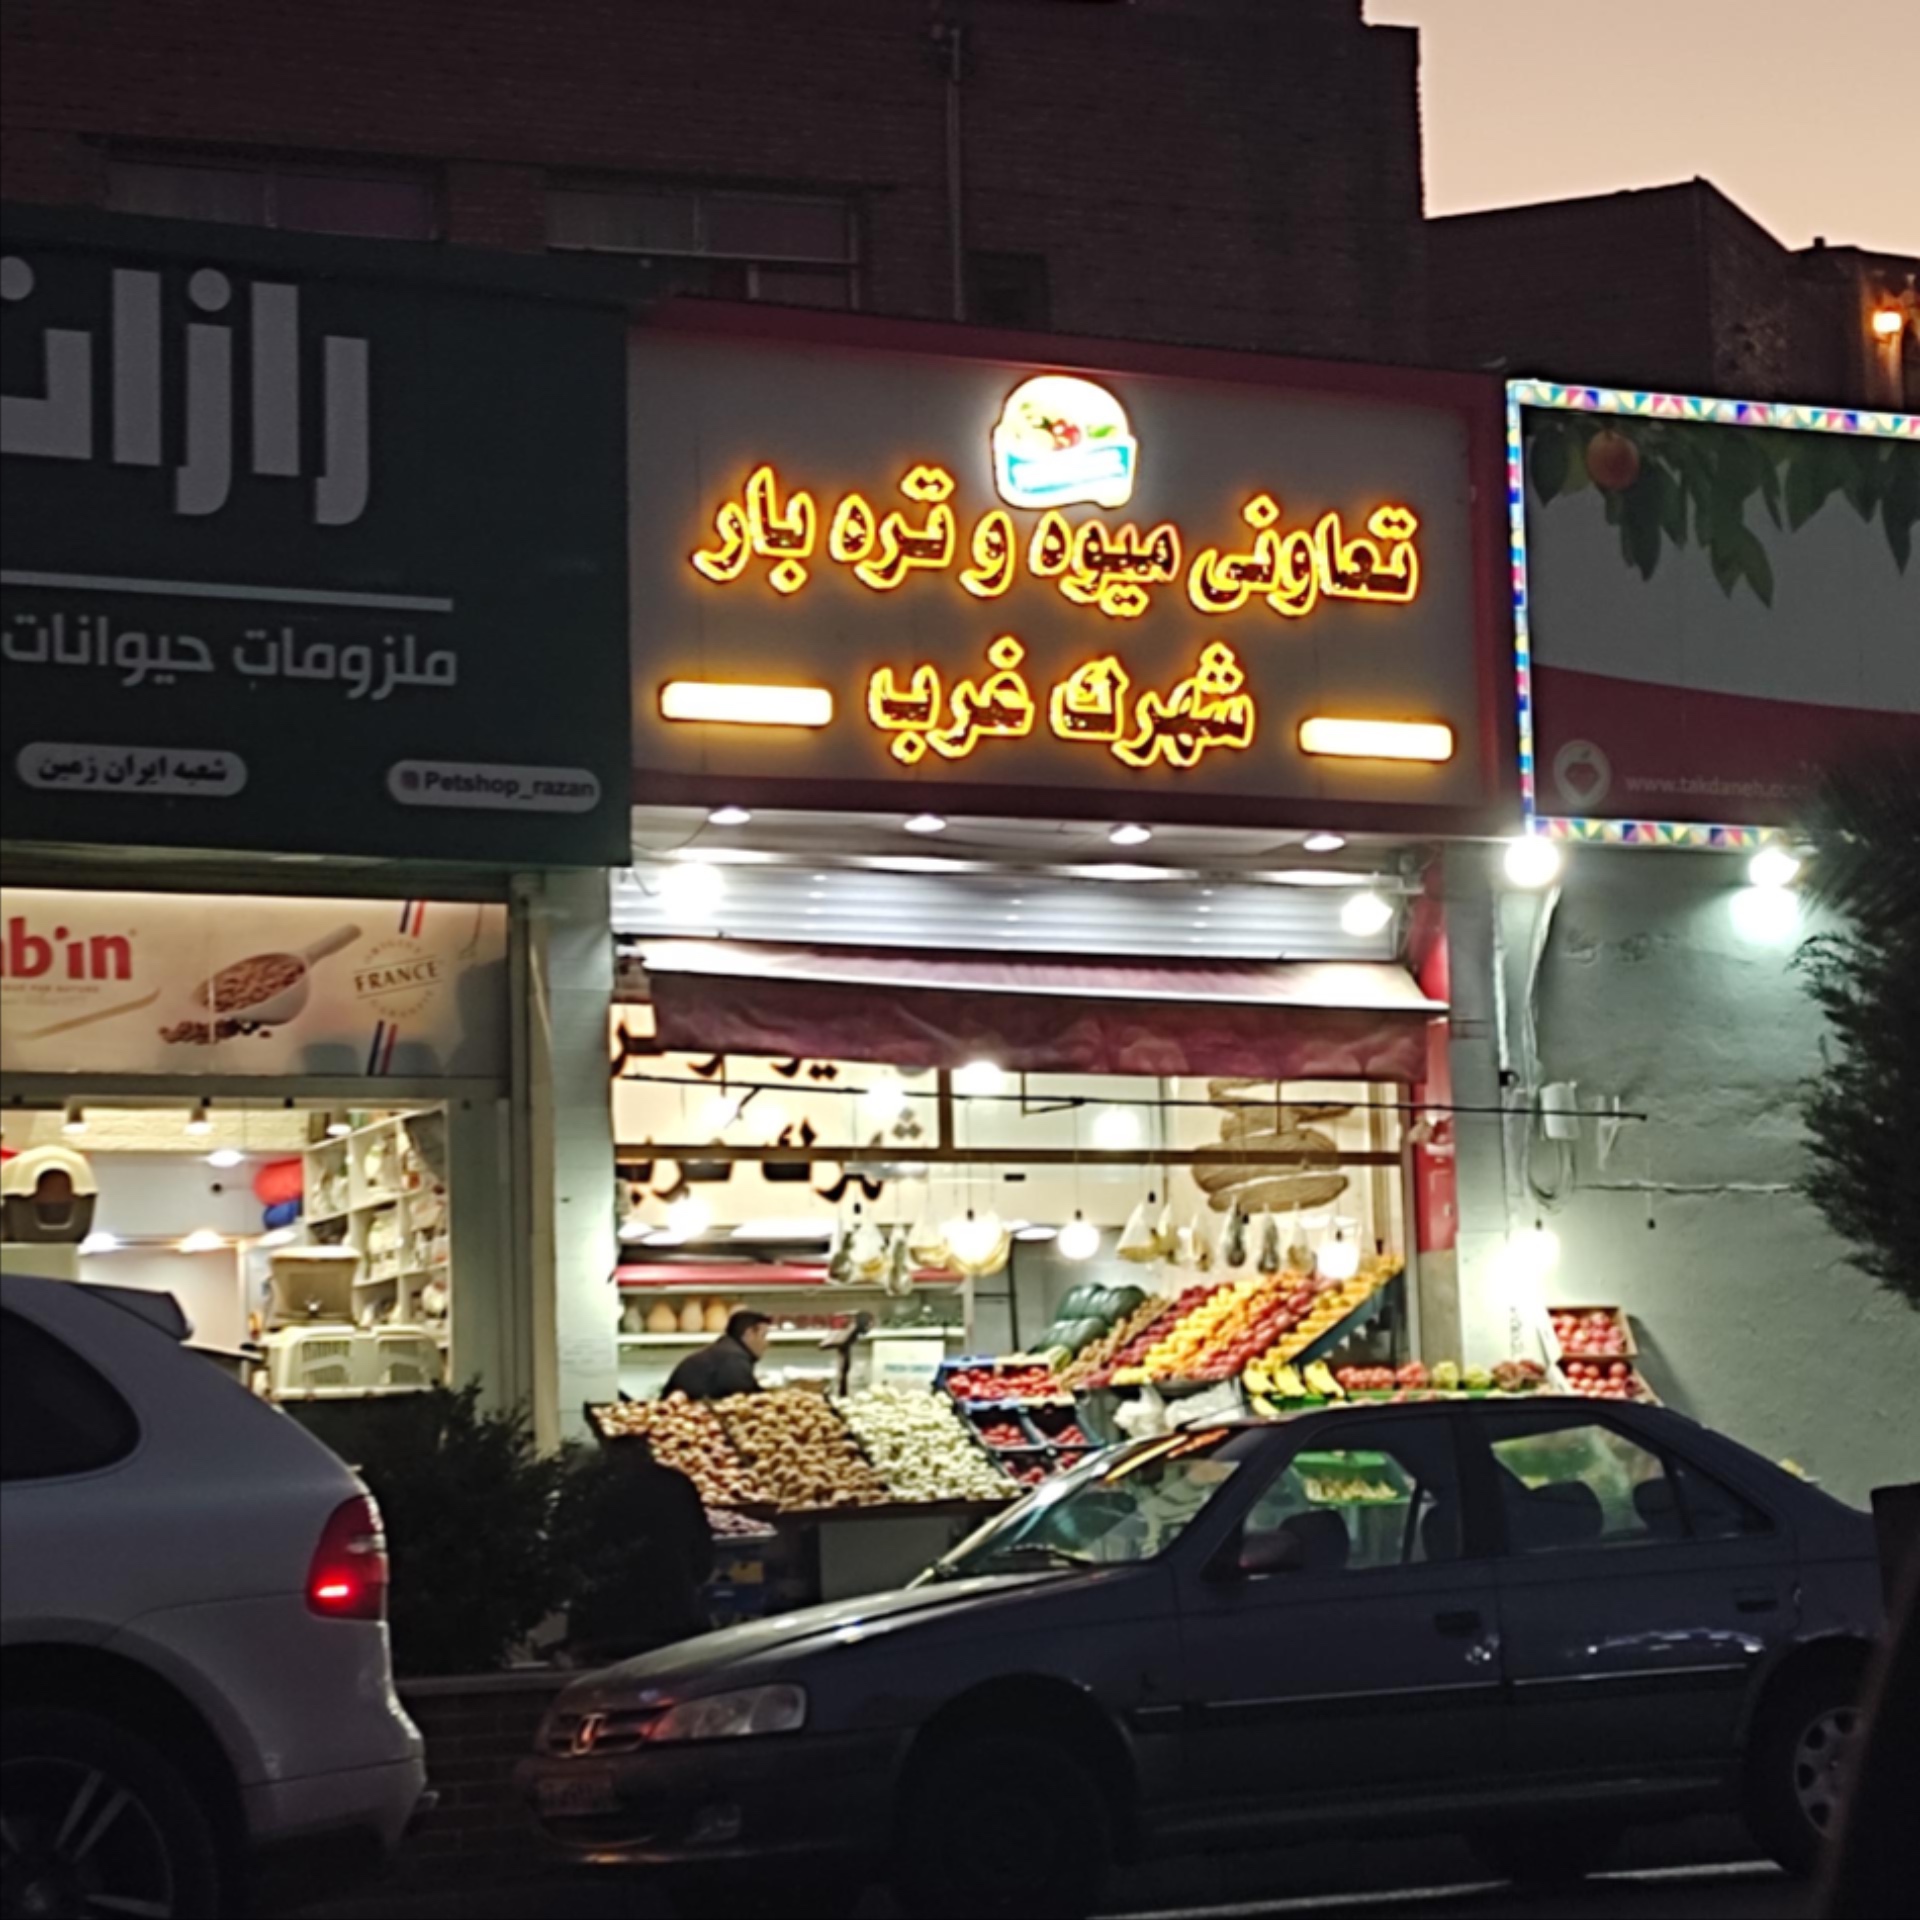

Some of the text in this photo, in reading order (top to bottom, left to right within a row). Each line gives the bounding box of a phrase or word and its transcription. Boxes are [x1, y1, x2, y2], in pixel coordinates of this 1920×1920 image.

[692, 465, 1419, 617] تعاونی میوه و تره بار
[1, 613, 458, 701] ملزومات حیوانات
[867, 635, 1035, 763] غرب
[37, 753, 228, 787] شعبه ایران زمین
[425, 770, 595, 800] Petshop_razan
[353, 960, 438, 992] FRANCE
